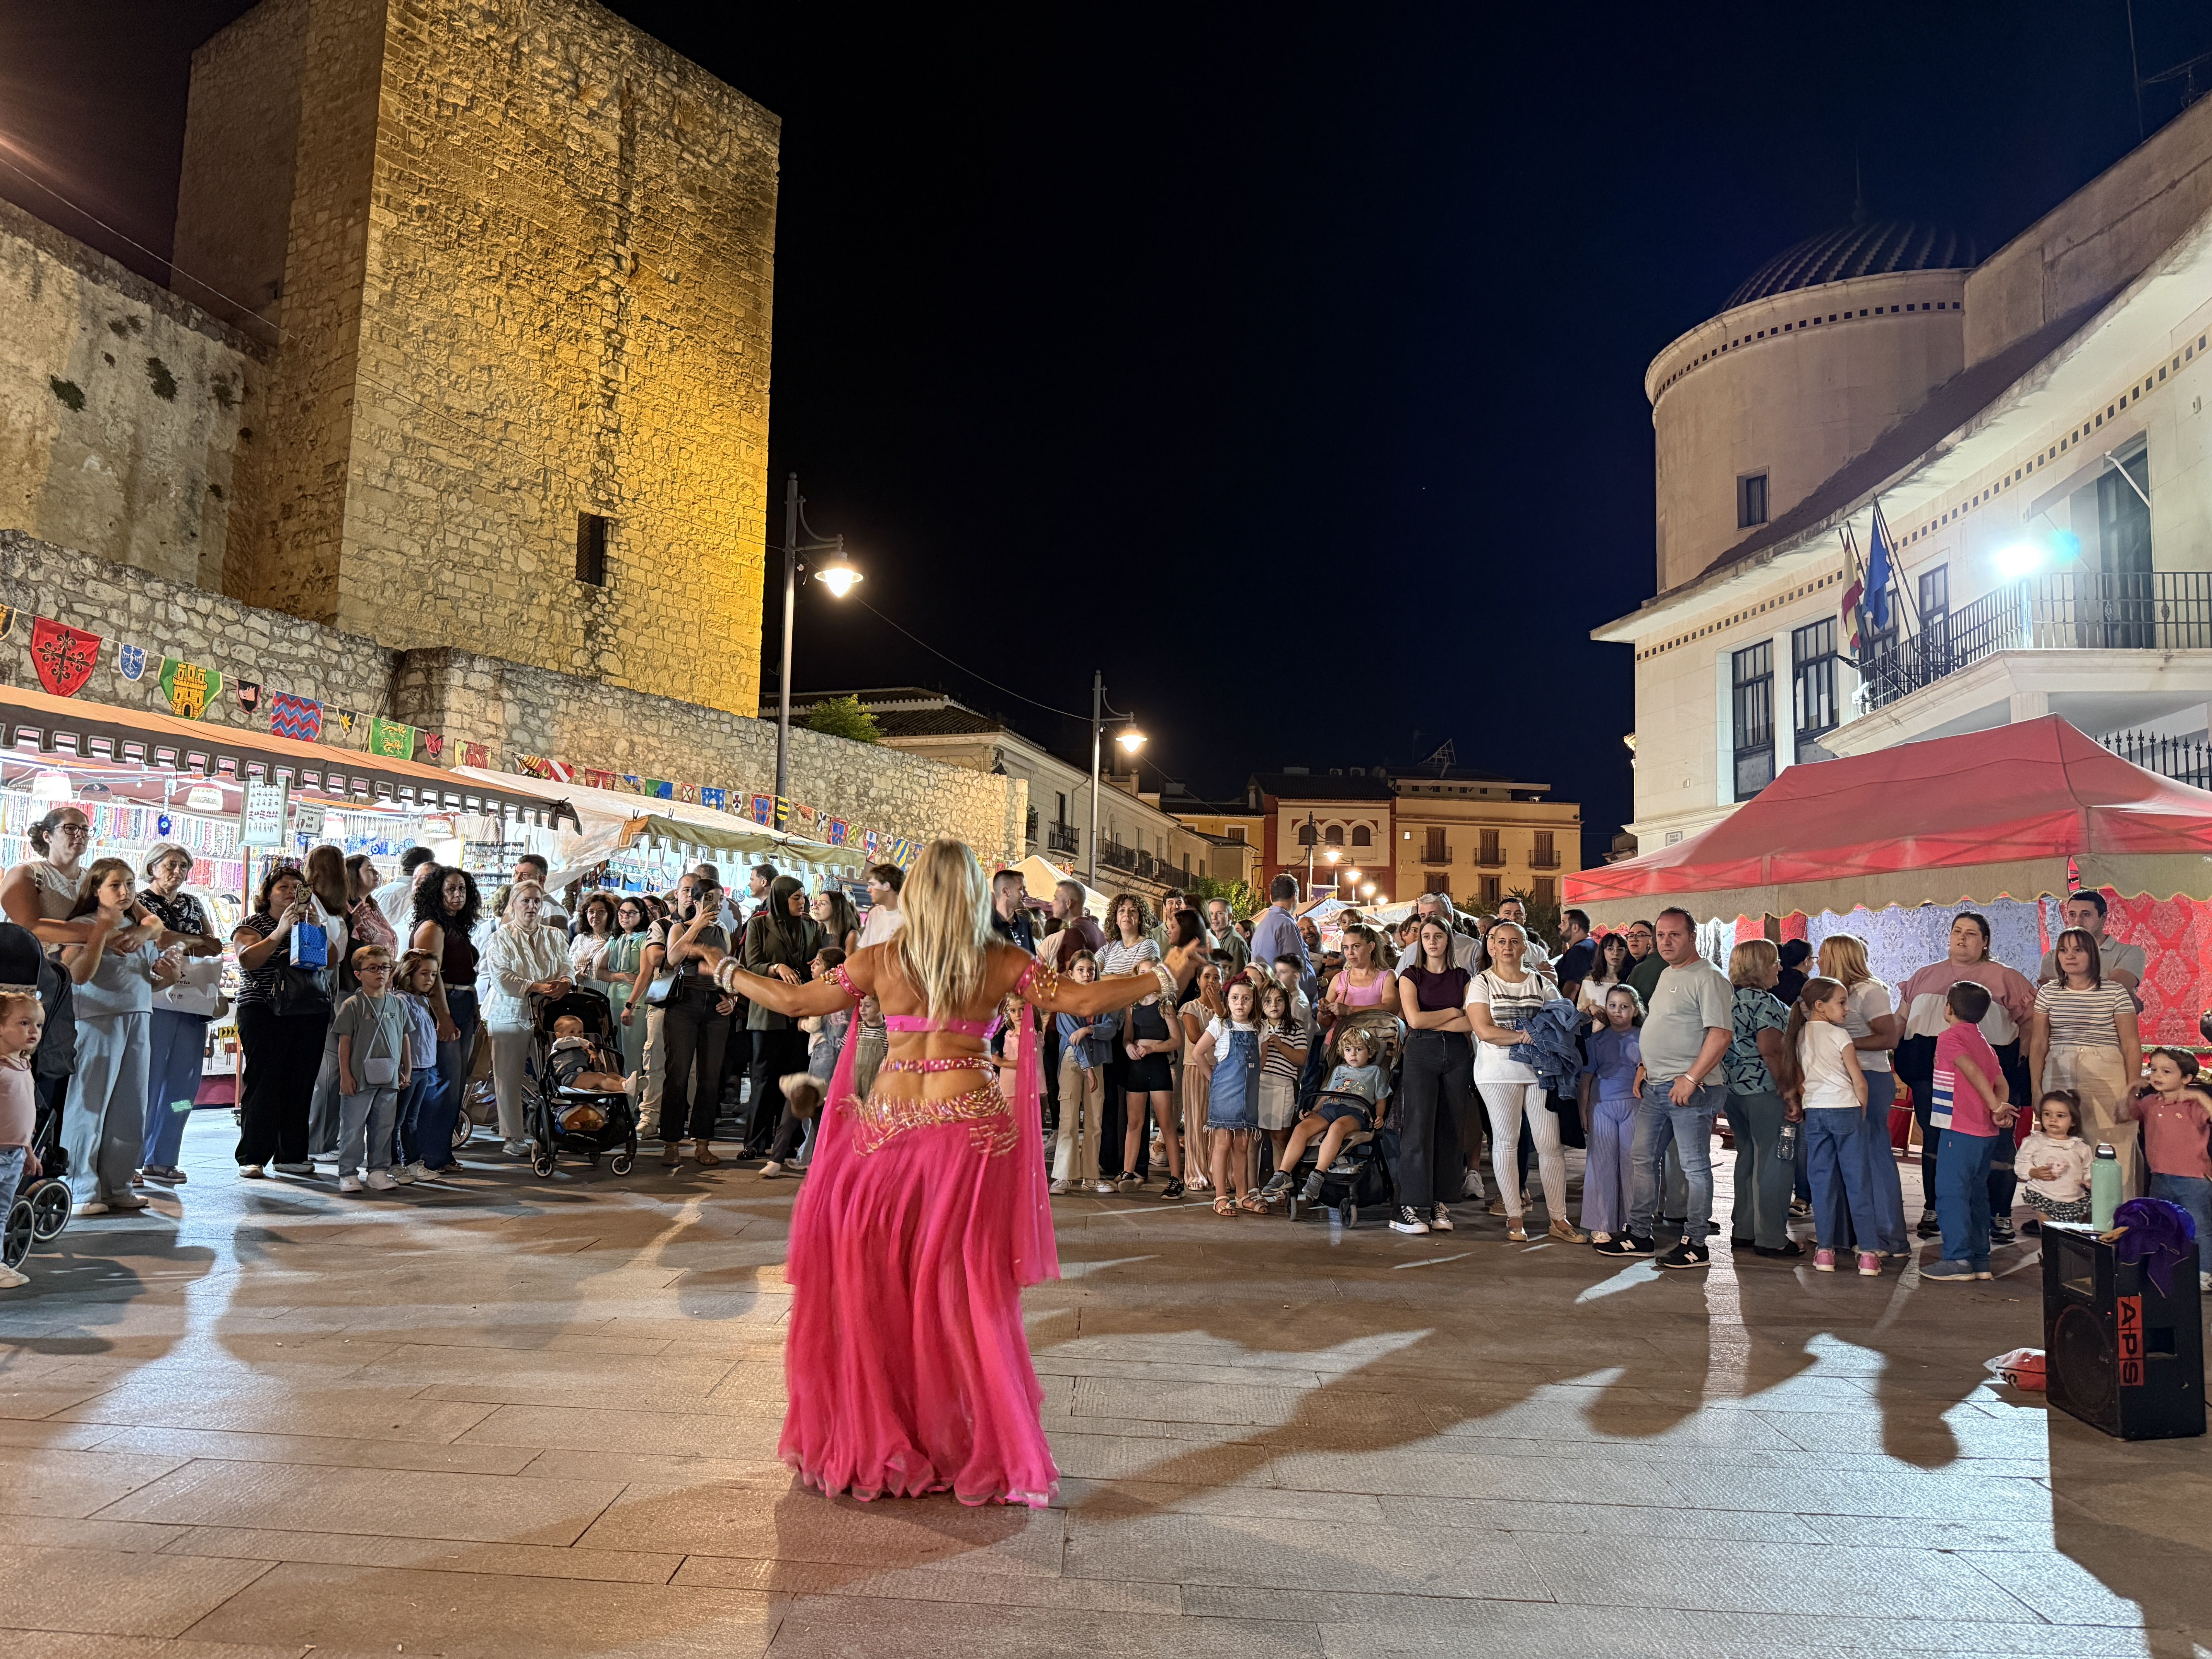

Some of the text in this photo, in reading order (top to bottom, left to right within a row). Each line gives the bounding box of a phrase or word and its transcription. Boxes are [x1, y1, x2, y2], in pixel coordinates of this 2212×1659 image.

[1620, 1239, 1636, 1251] N
[1684, 1251, 1699, 1263] N
[2121, 1301, 2138, 1384] APS
